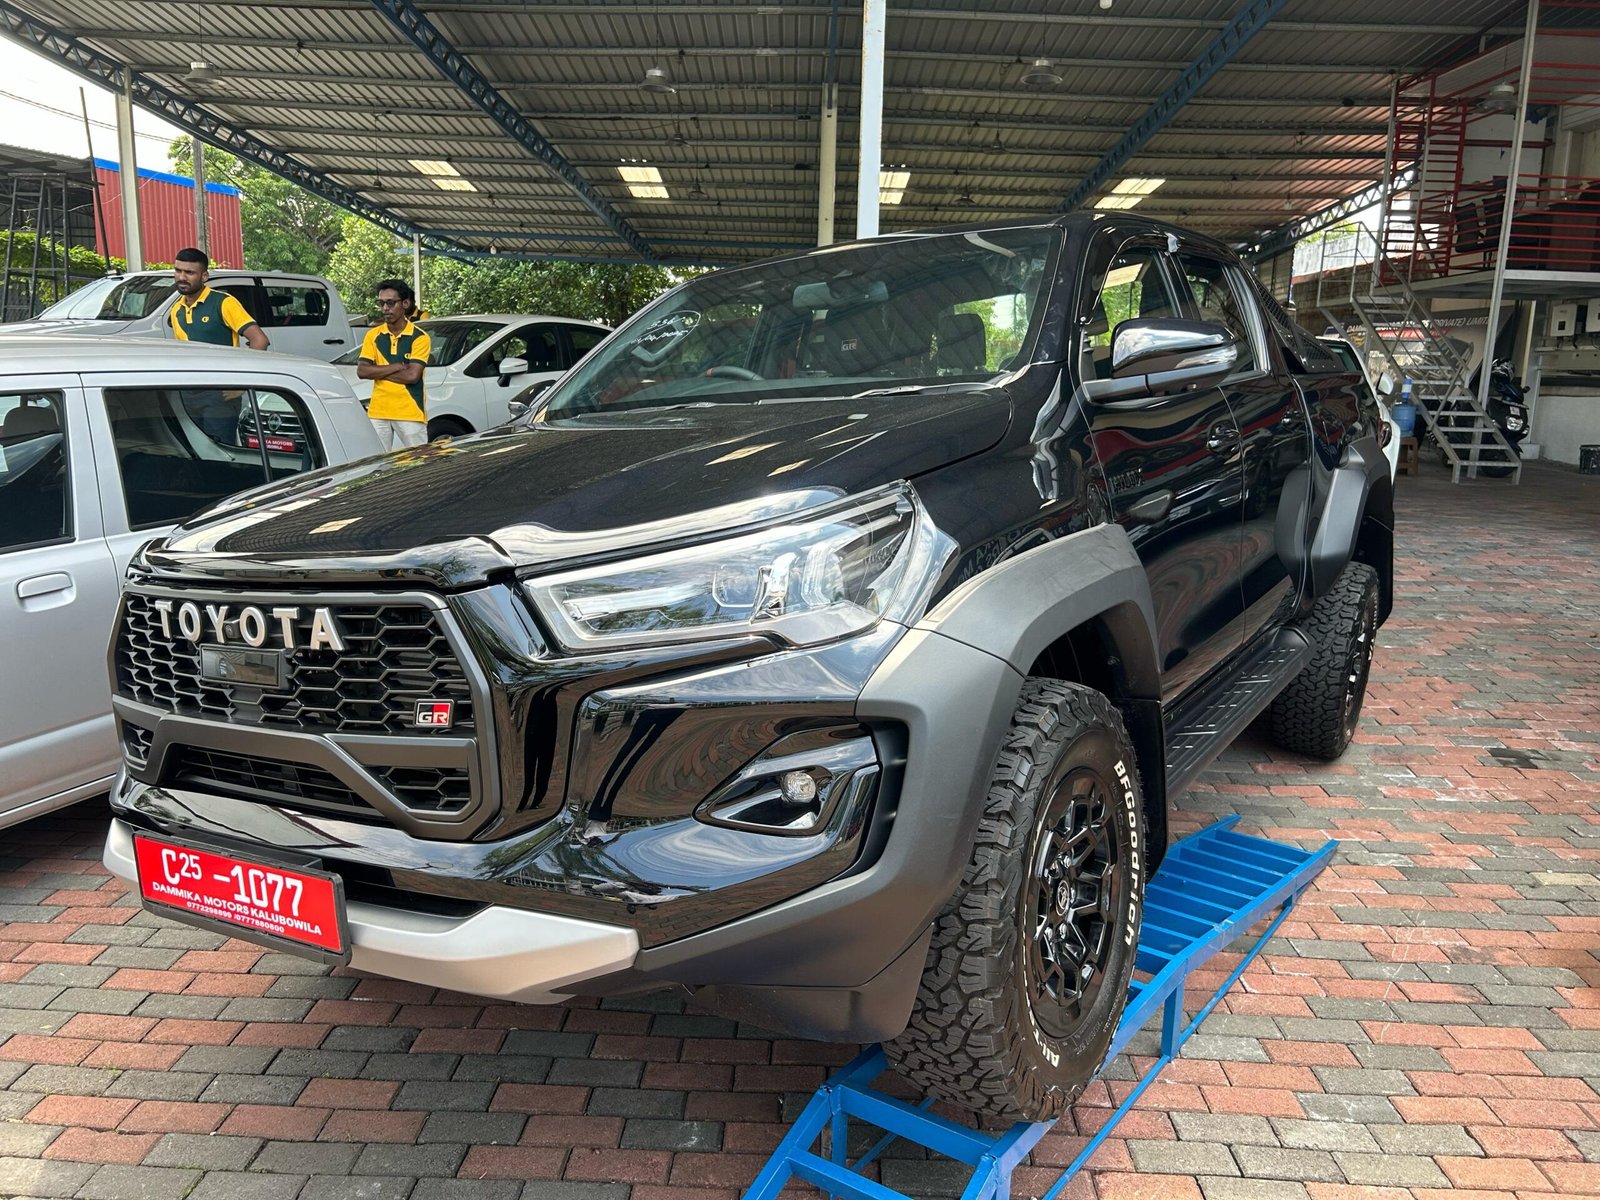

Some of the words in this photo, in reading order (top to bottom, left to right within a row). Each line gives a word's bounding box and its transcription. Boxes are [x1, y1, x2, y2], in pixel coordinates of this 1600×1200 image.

[155, 600, 344, 651] TOYOTA
[418, 711, 449, 725] GR
[1113, 760, 1140, 946] BFGoodrich
[152, 882, 202, 902] DAMMIKA
[203, 895, 249, 915] MOTORS
[250, 907, 322, 936] KALUBOWILA
